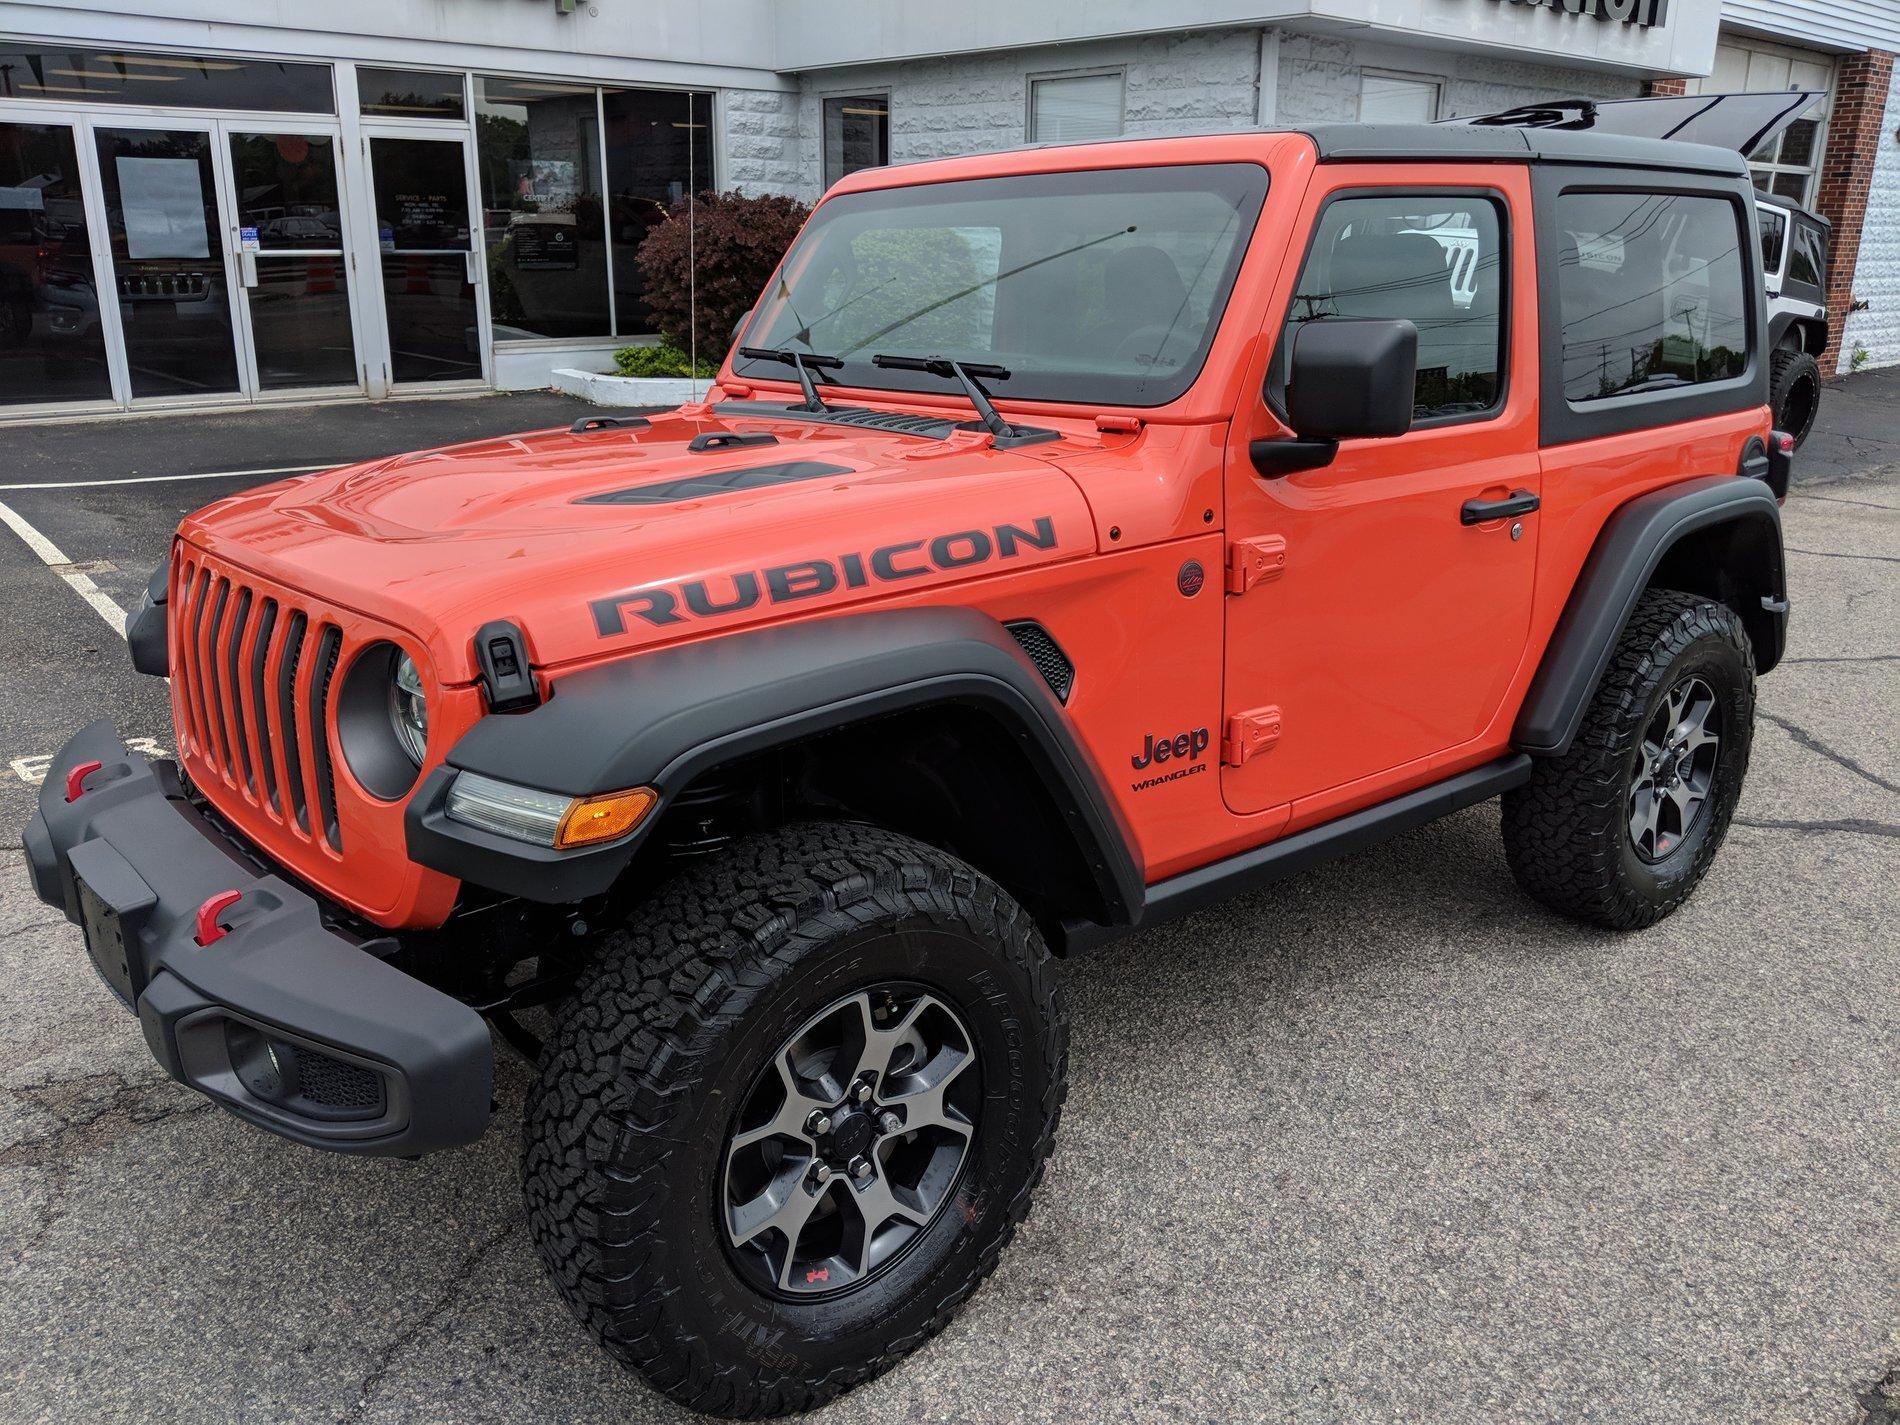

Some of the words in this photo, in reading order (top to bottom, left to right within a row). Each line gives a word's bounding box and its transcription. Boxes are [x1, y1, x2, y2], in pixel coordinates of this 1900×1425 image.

[587, 516, 1058, 639] RUBICON
[1131, 727, 1210, 770] Jeep
[1131, 764, 1207, 792] WRANGLER
